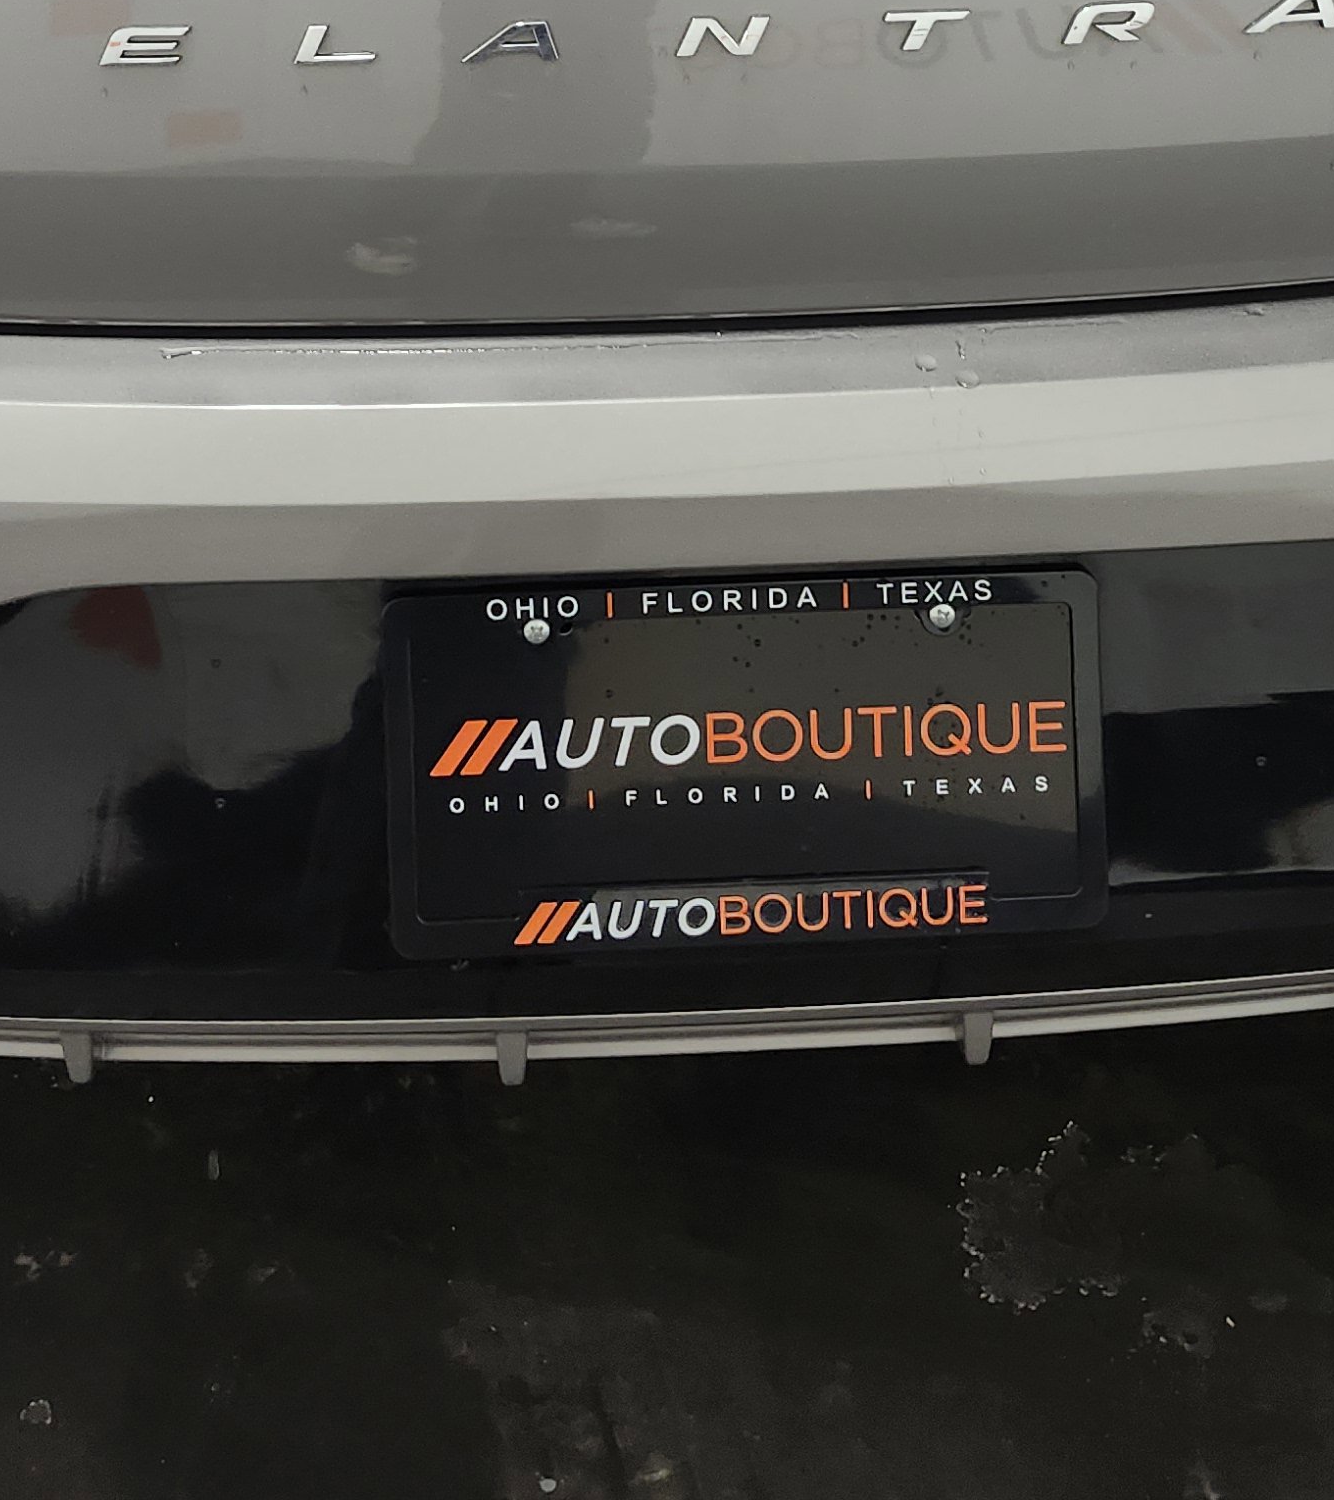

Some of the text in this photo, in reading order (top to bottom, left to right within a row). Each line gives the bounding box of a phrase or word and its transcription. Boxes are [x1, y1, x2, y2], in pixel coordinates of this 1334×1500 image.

[486, 579, 993, 621] OHIO FLORIDA TEXAS
[499, 701, 1067, 772] AUTOBOUTIQUE
[448, 775, 1051, 815] OHIO FLORIDA TEXAS
[567, 884, 989, 942] AUTOBOUTIQUE
